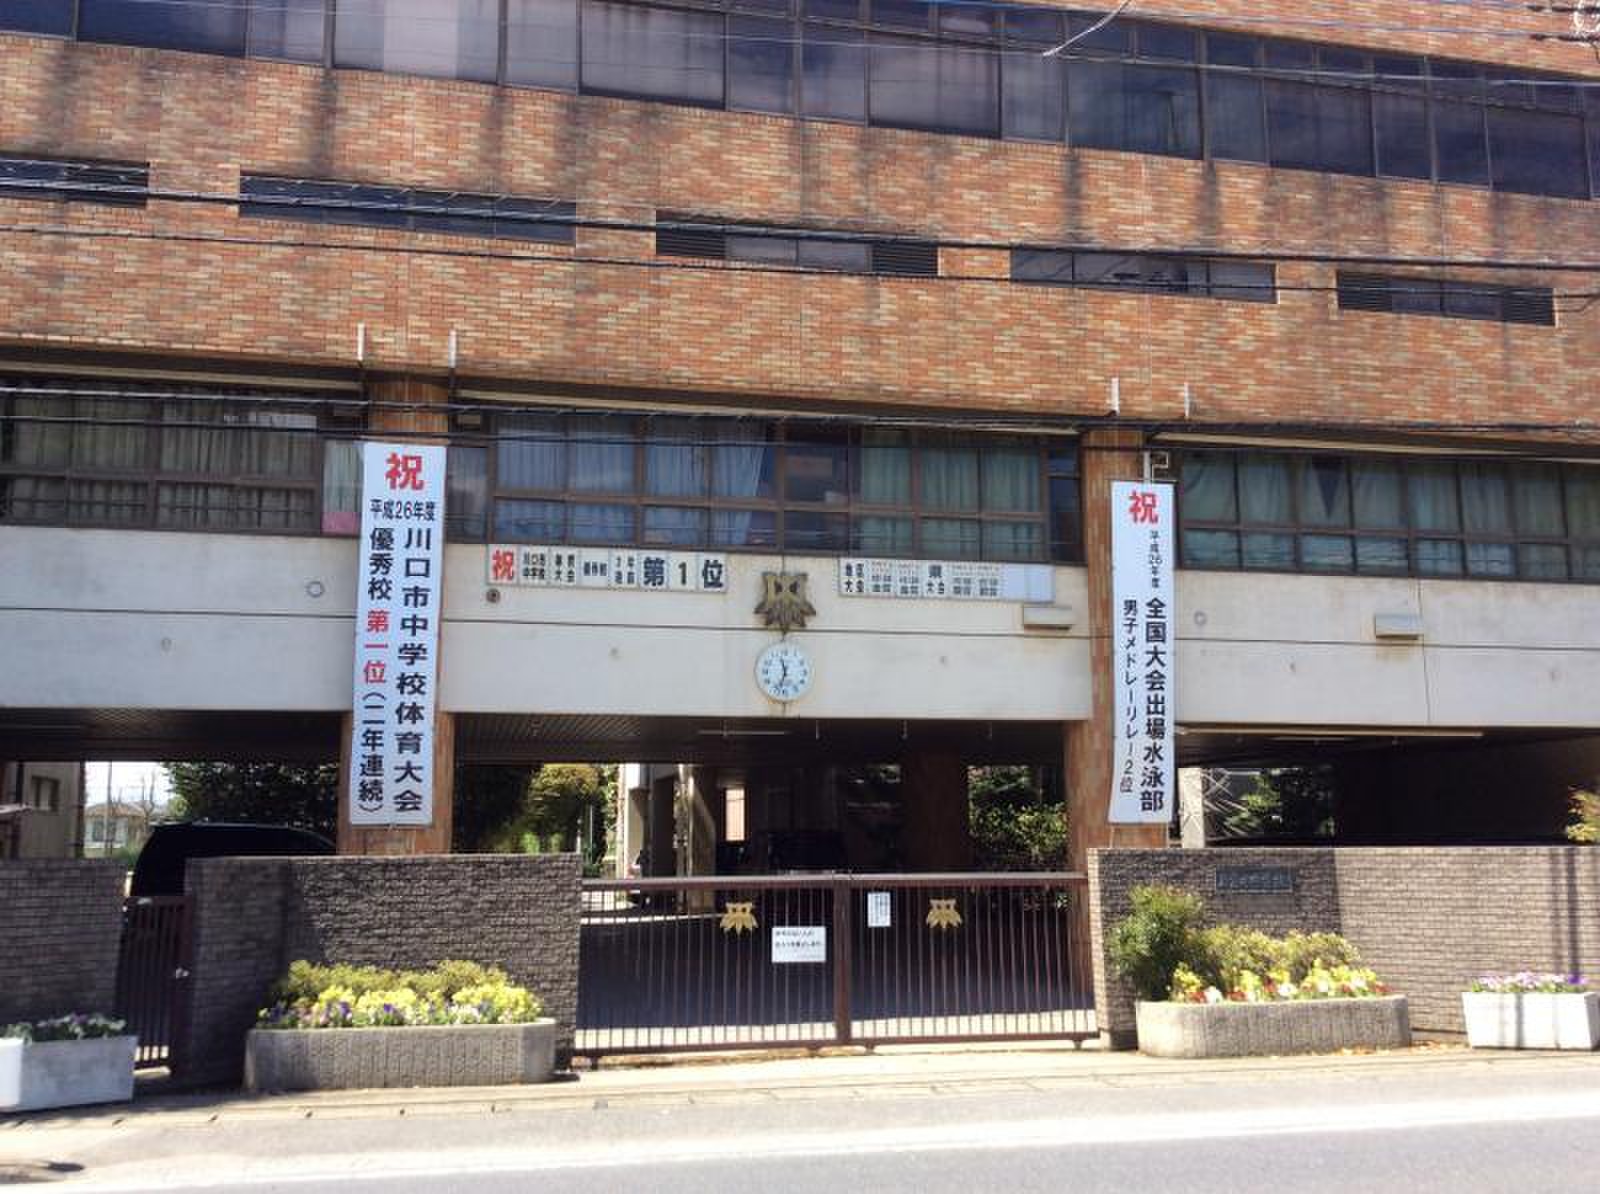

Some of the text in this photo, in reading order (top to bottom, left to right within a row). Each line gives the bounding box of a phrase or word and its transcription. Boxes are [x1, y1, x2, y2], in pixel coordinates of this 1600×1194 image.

[384, 451, 425, 491] 祝
[369, 498, 438, 522] 平成26年度
[1128, 489, 1160, 525] 祝
[492, 549, 514, 581] 祝
[392, 527, 433, 813] 川口市中学校体育大会
[1139, 597, 1168, 814] 全国大会出場水泳部
